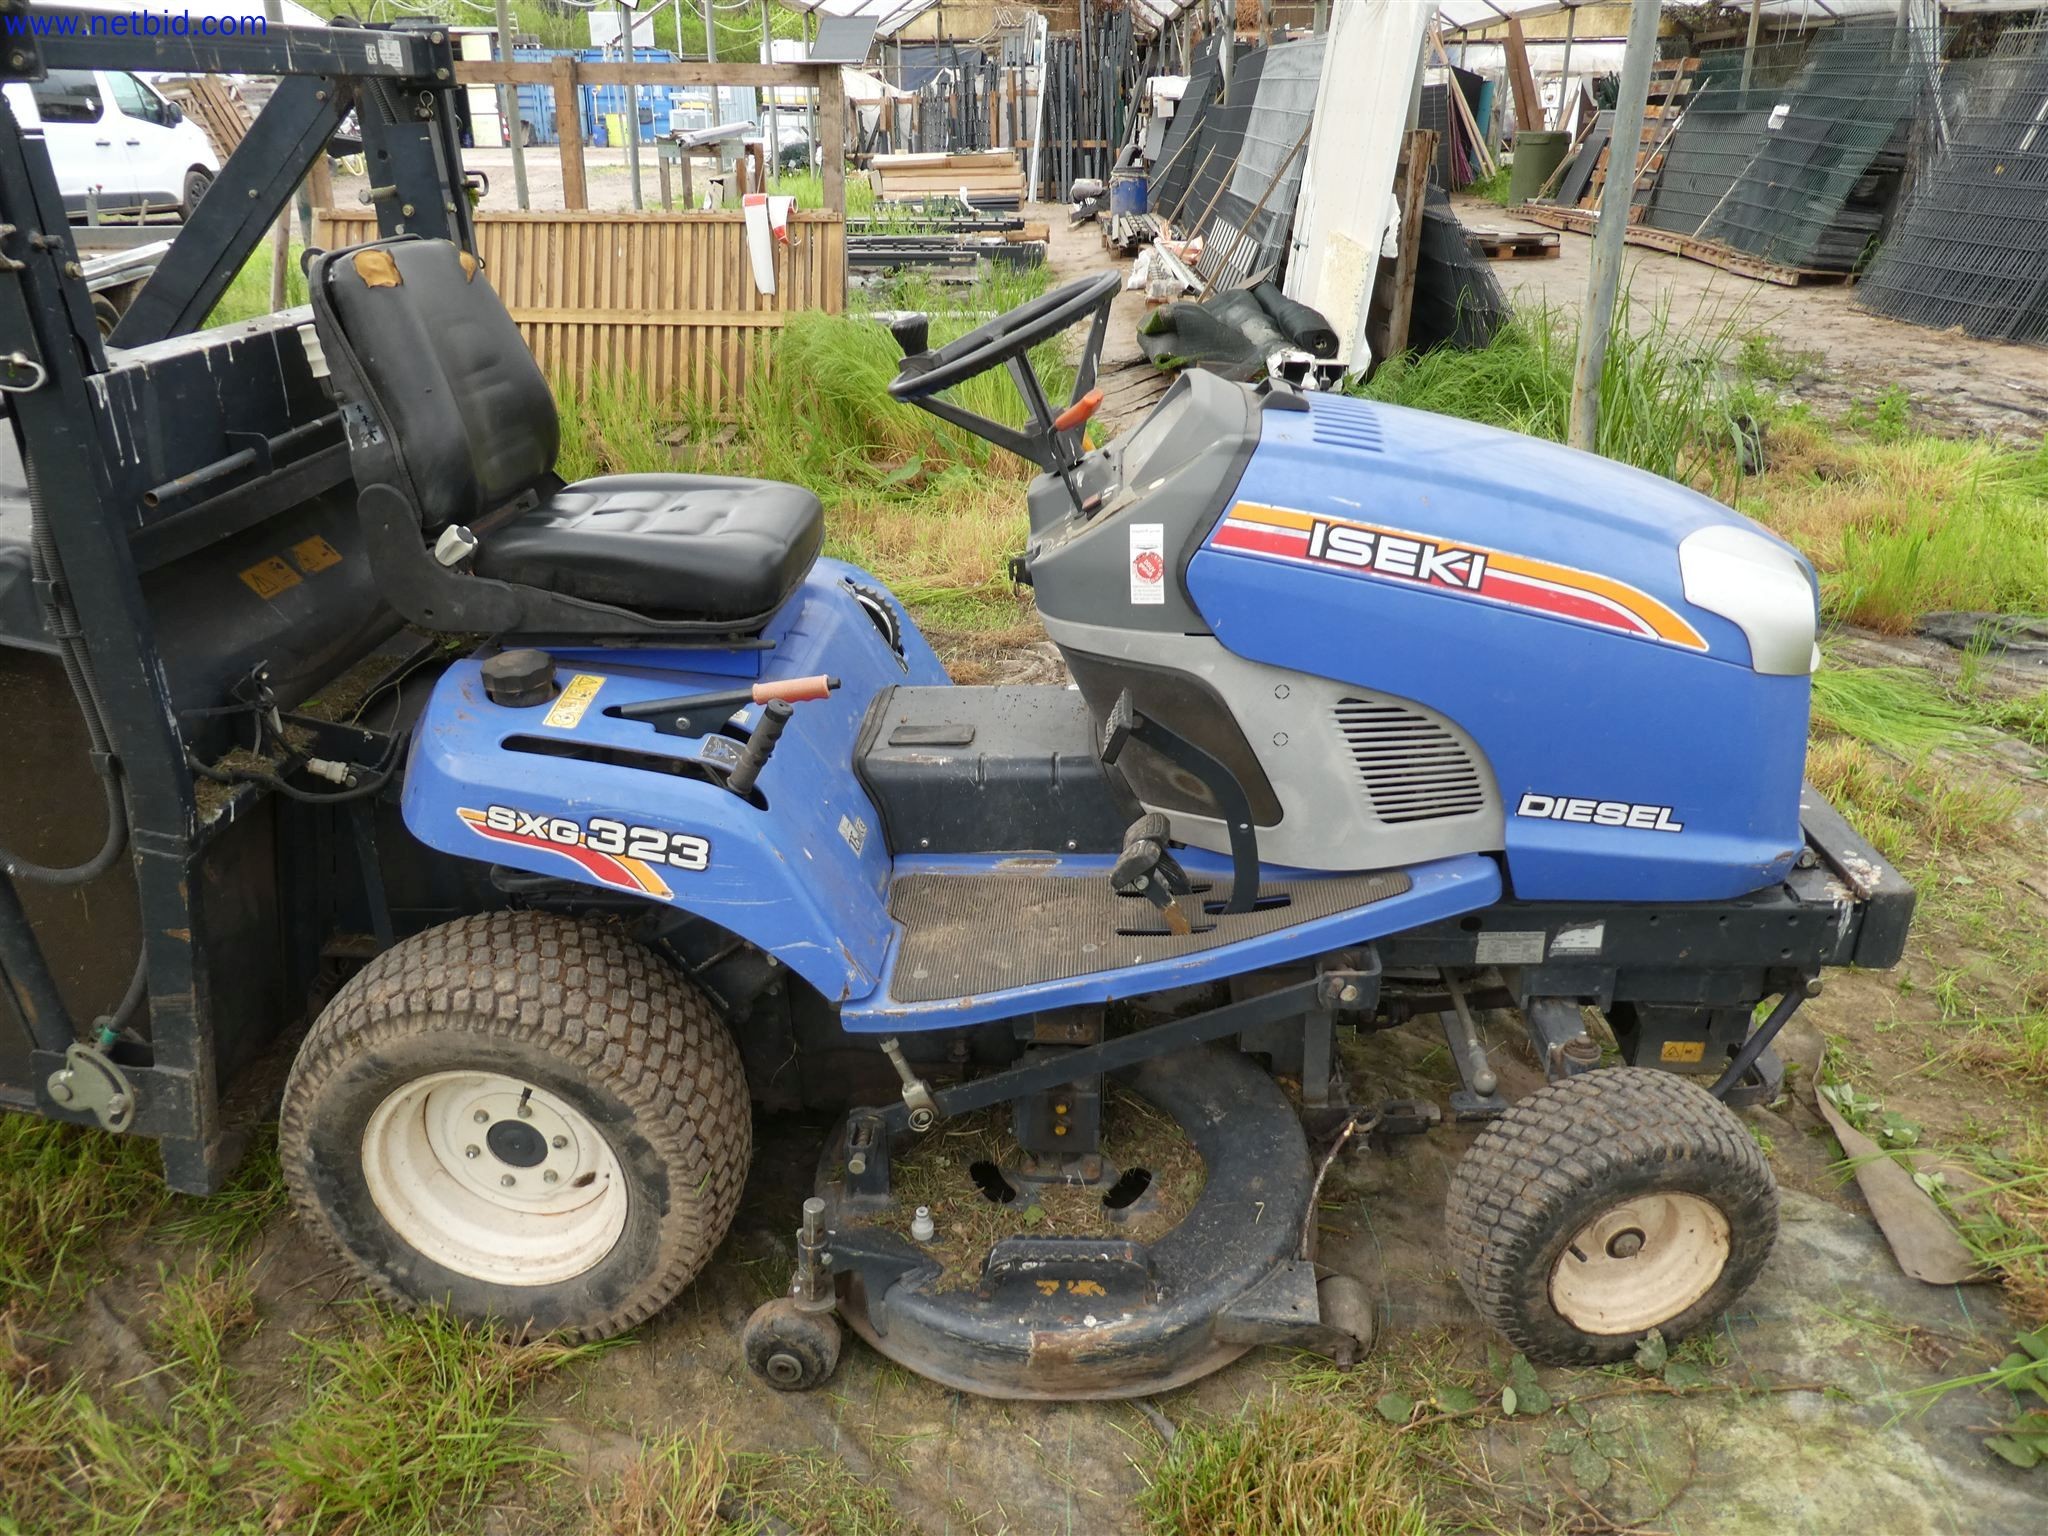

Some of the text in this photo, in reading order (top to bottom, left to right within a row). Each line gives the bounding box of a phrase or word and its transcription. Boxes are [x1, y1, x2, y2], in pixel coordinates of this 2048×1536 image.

[1308, 521, 1487, 590] ISEKI
[486, 805, 710, 871] SXG 323
[1517, 794, 1683, 832] DIESEL
